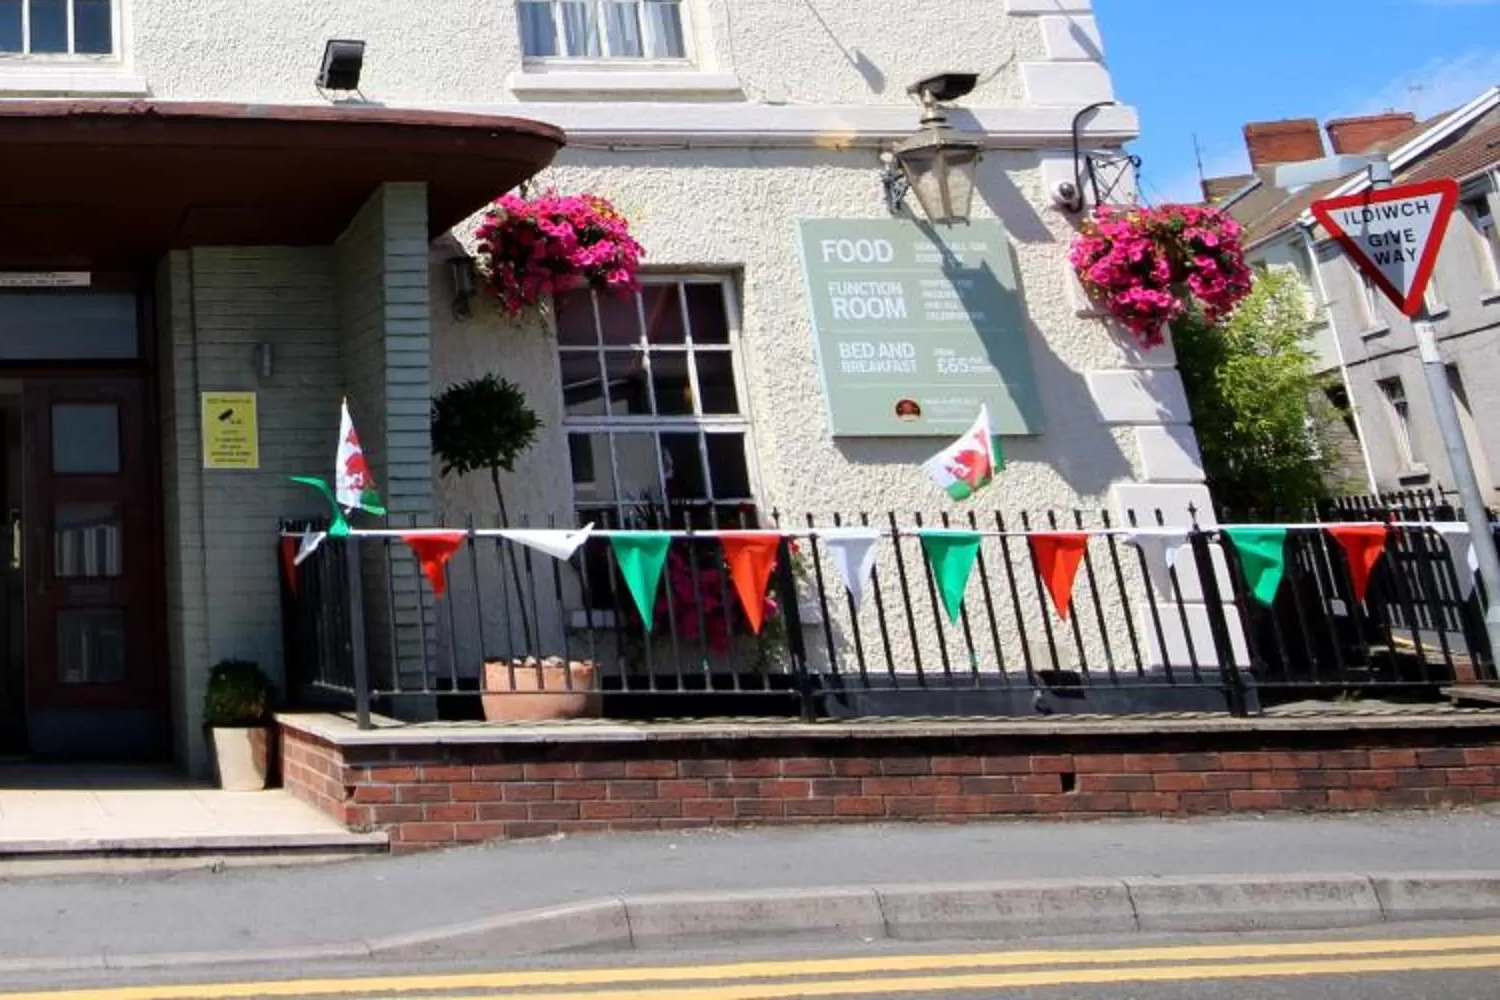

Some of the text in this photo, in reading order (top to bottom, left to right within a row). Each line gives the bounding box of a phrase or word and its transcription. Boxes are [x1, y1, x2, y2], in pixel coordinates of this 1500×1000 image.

[1343, 199, 1431, 226] ILDIWCH
[1368, 228, 1417, 248] GIVE
[820, 239, 894, 264] FOOD
[1373, 248, 1417, 266] WAY
[827, 281, 904, 298] FUNCTION
[832, 297, 908, 321] ROOM
[838, 341, 916, 359] BED AND
[840, 359, 917, 374] BREAKFAST
[936, 356, 970, 374] £65
